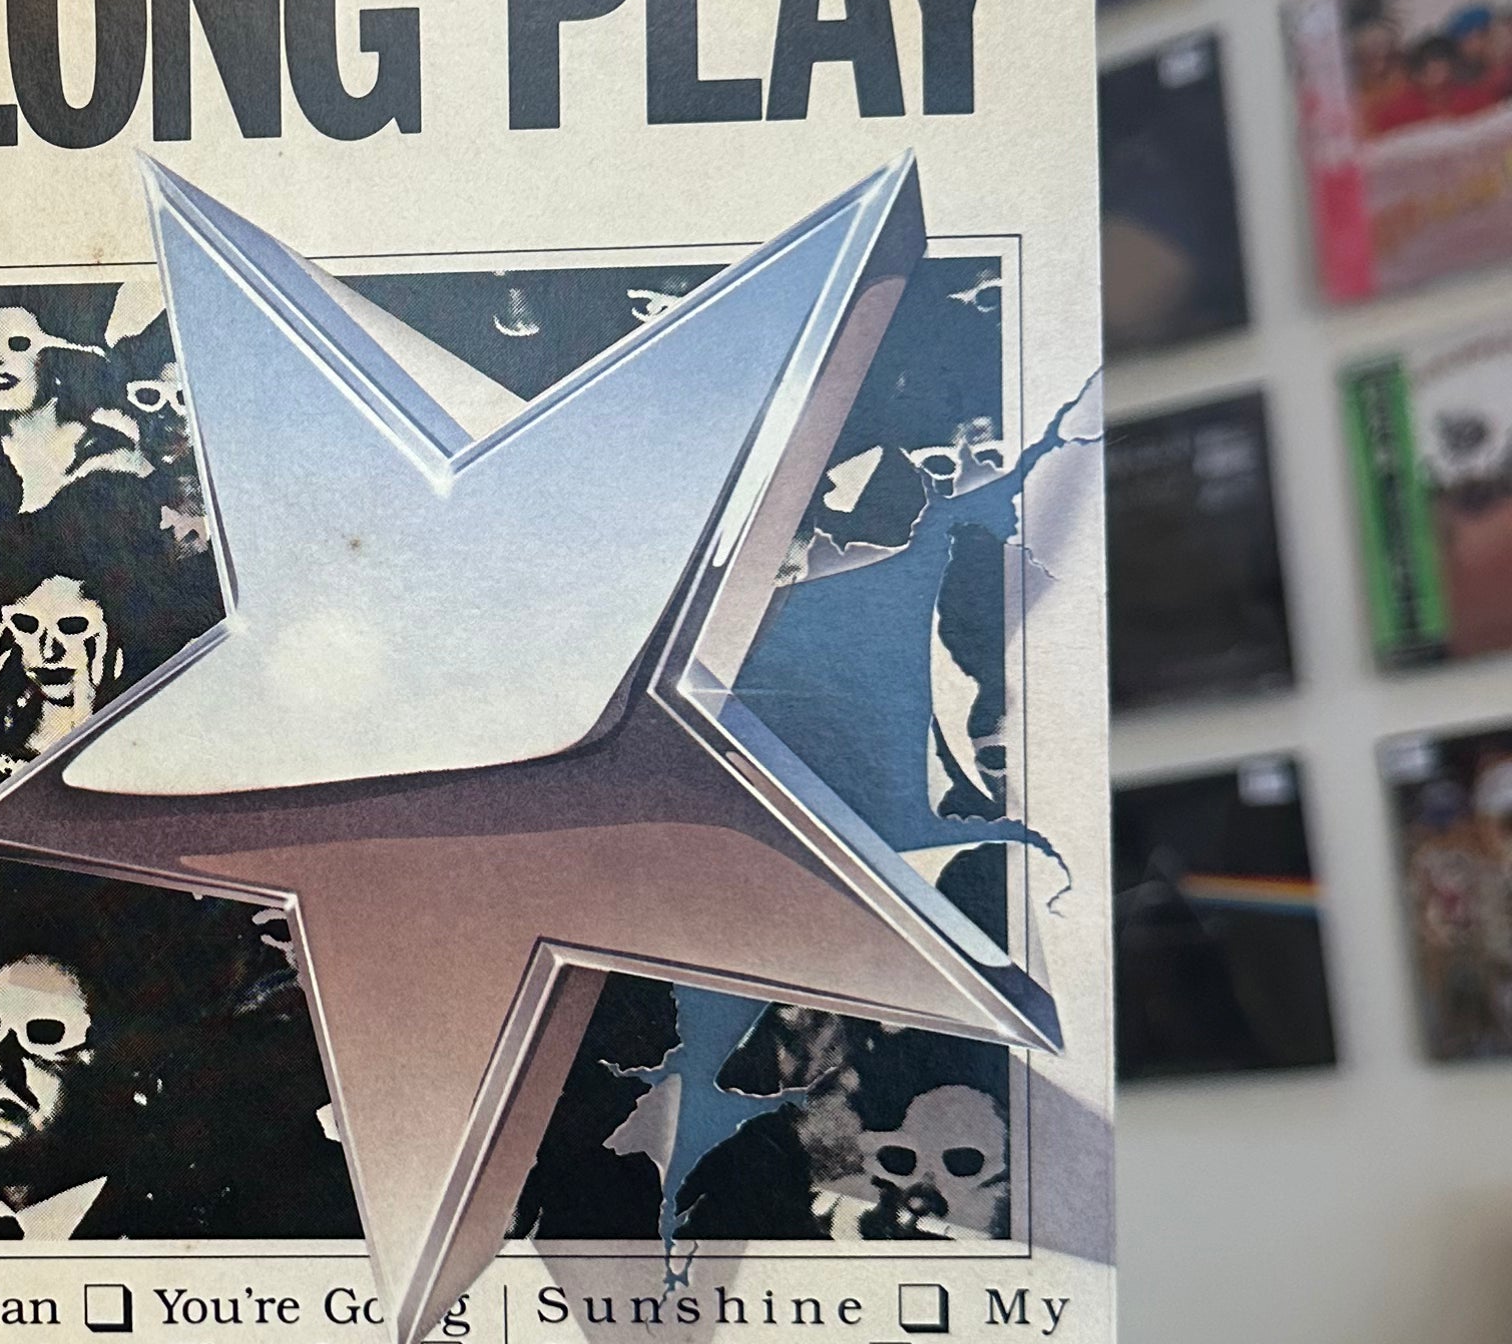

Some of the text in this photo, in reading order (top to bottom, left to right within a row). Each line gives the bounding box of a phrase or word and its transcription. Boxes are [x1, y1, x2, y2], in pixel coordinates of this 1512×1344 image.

[152, 1286, 302, 1326] You're
[536, 1286, 1070, 1336] Sunshine My
